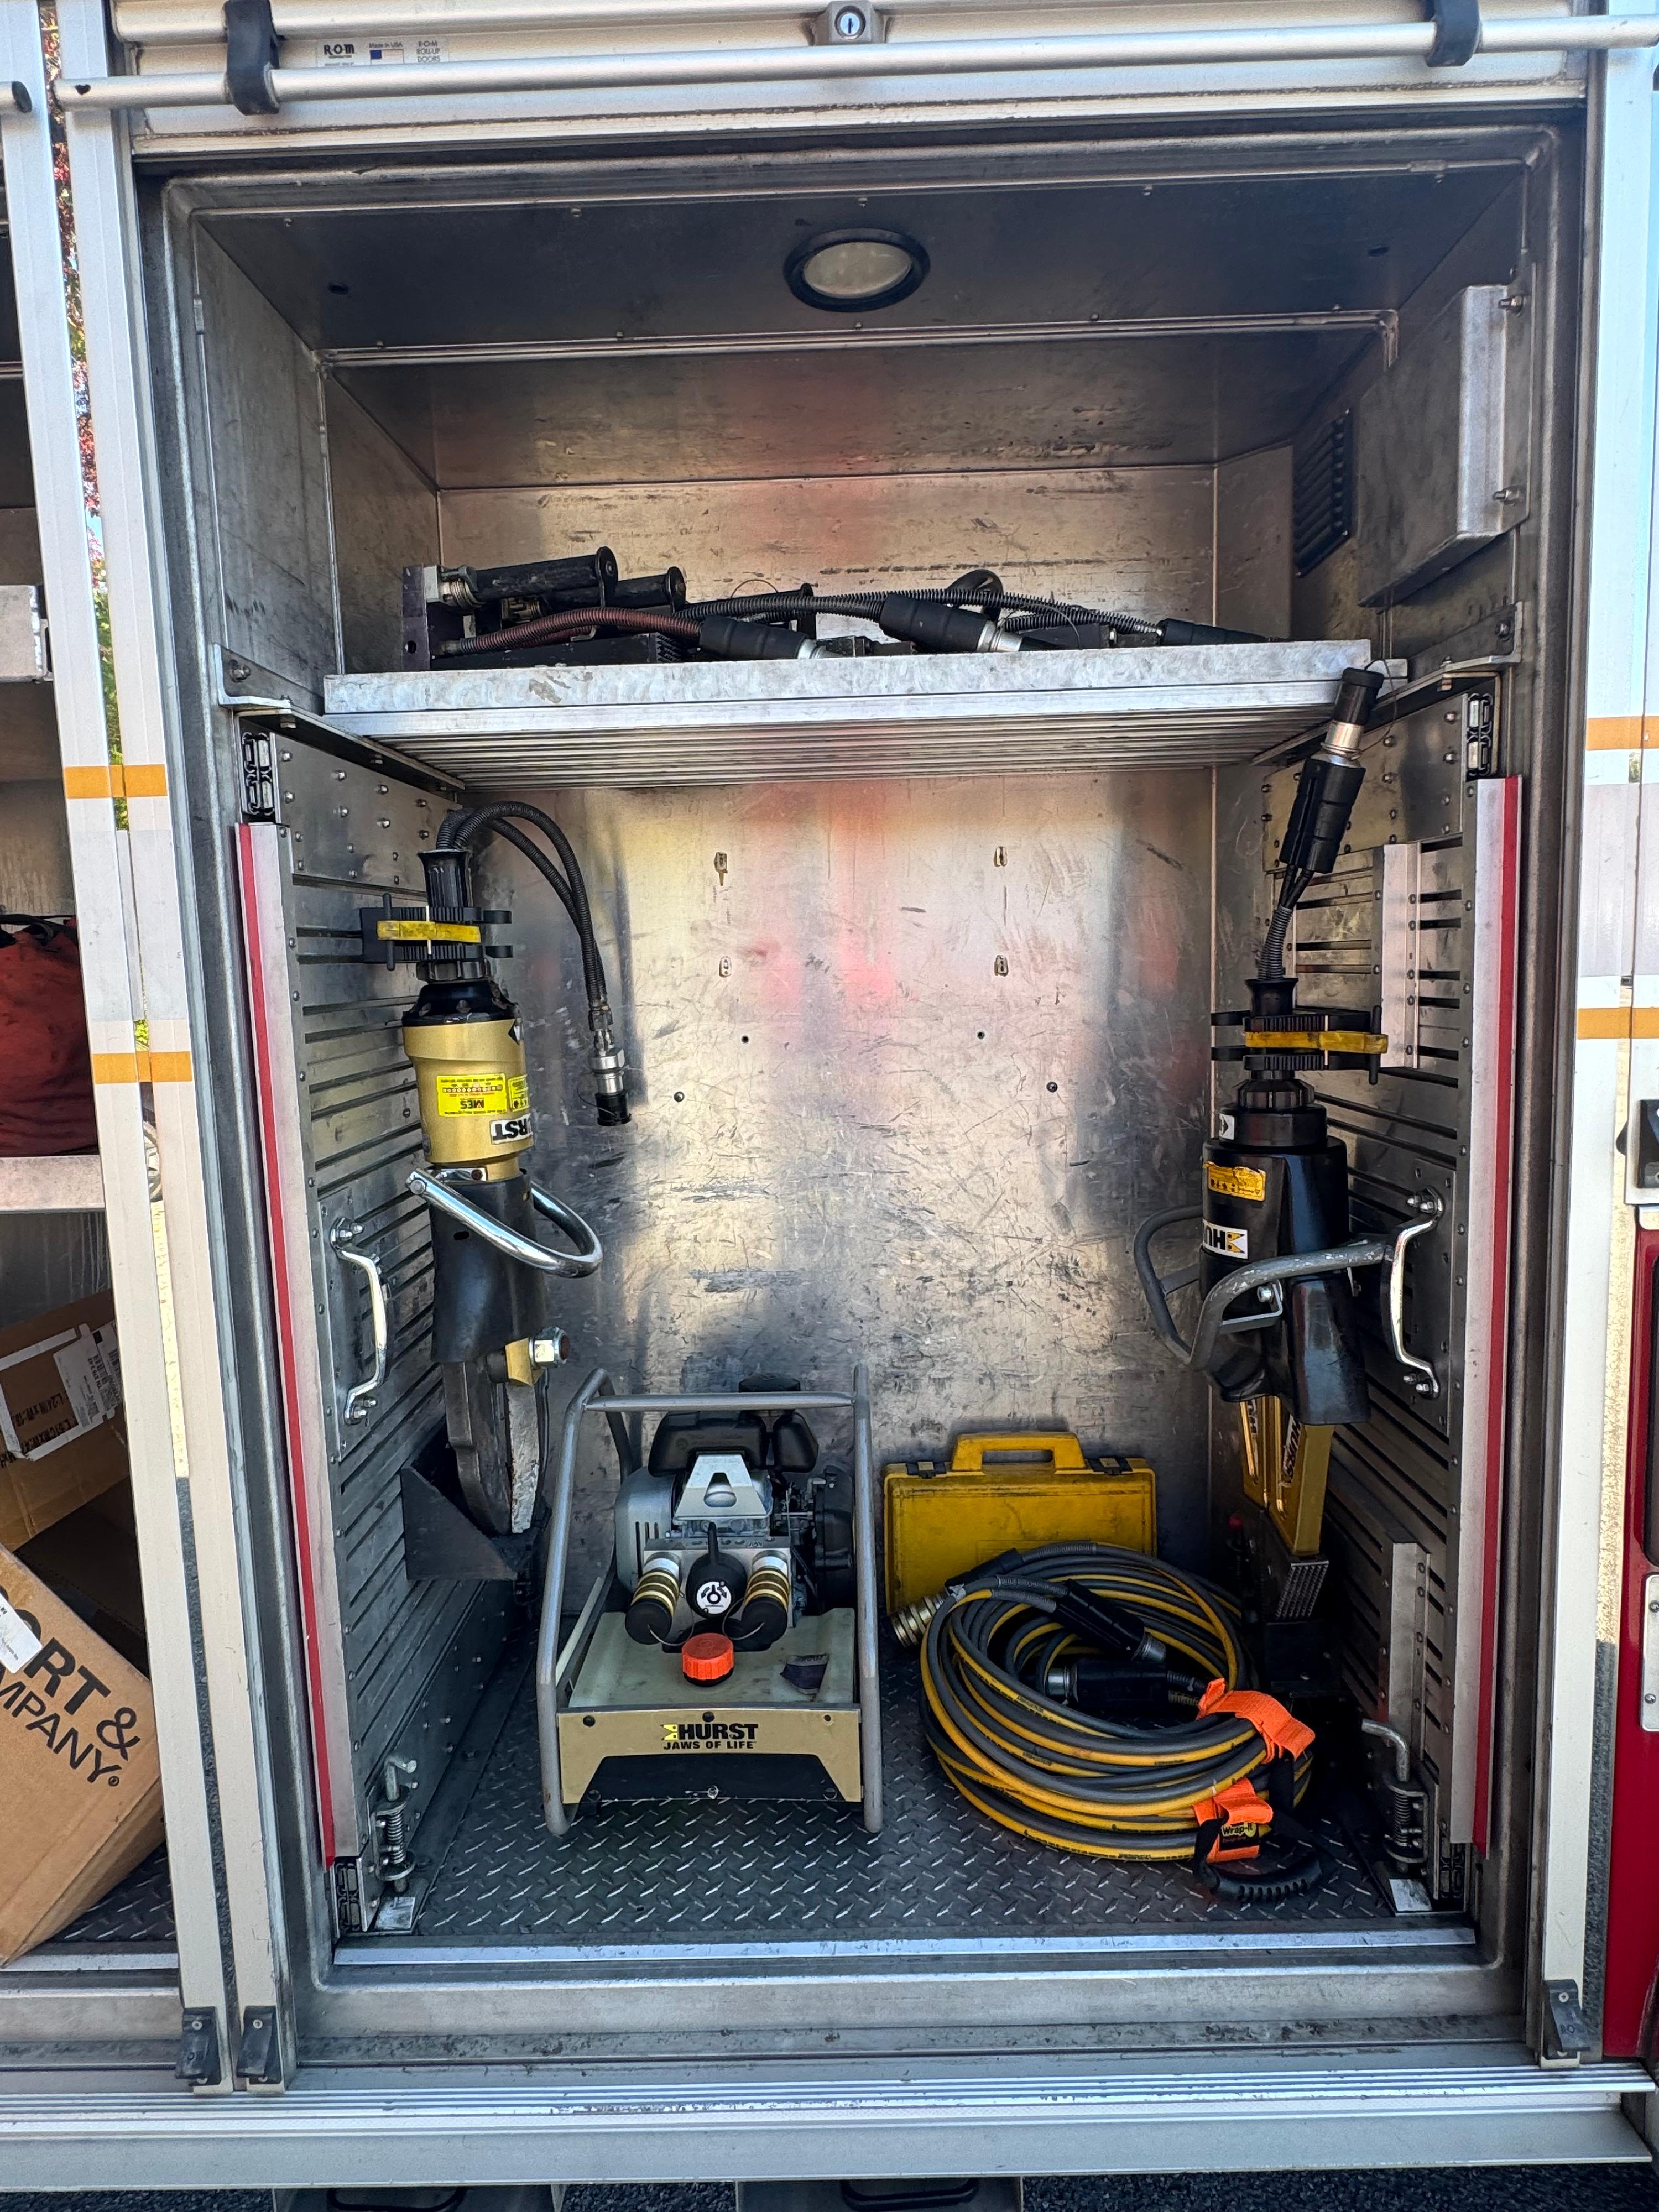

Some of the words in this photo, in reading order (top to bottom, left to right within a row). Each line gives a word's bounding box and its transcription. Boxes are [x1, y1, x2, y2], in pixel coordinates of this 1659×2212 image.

[96, 1707, 140, 1761] &
[679, 1723, 758, 1740] HURST
[664, 1741, 701, 1750] JAWS
[706, 1741, 722, 1749] OF
[727, 1741, 754, 1749] LIFE
